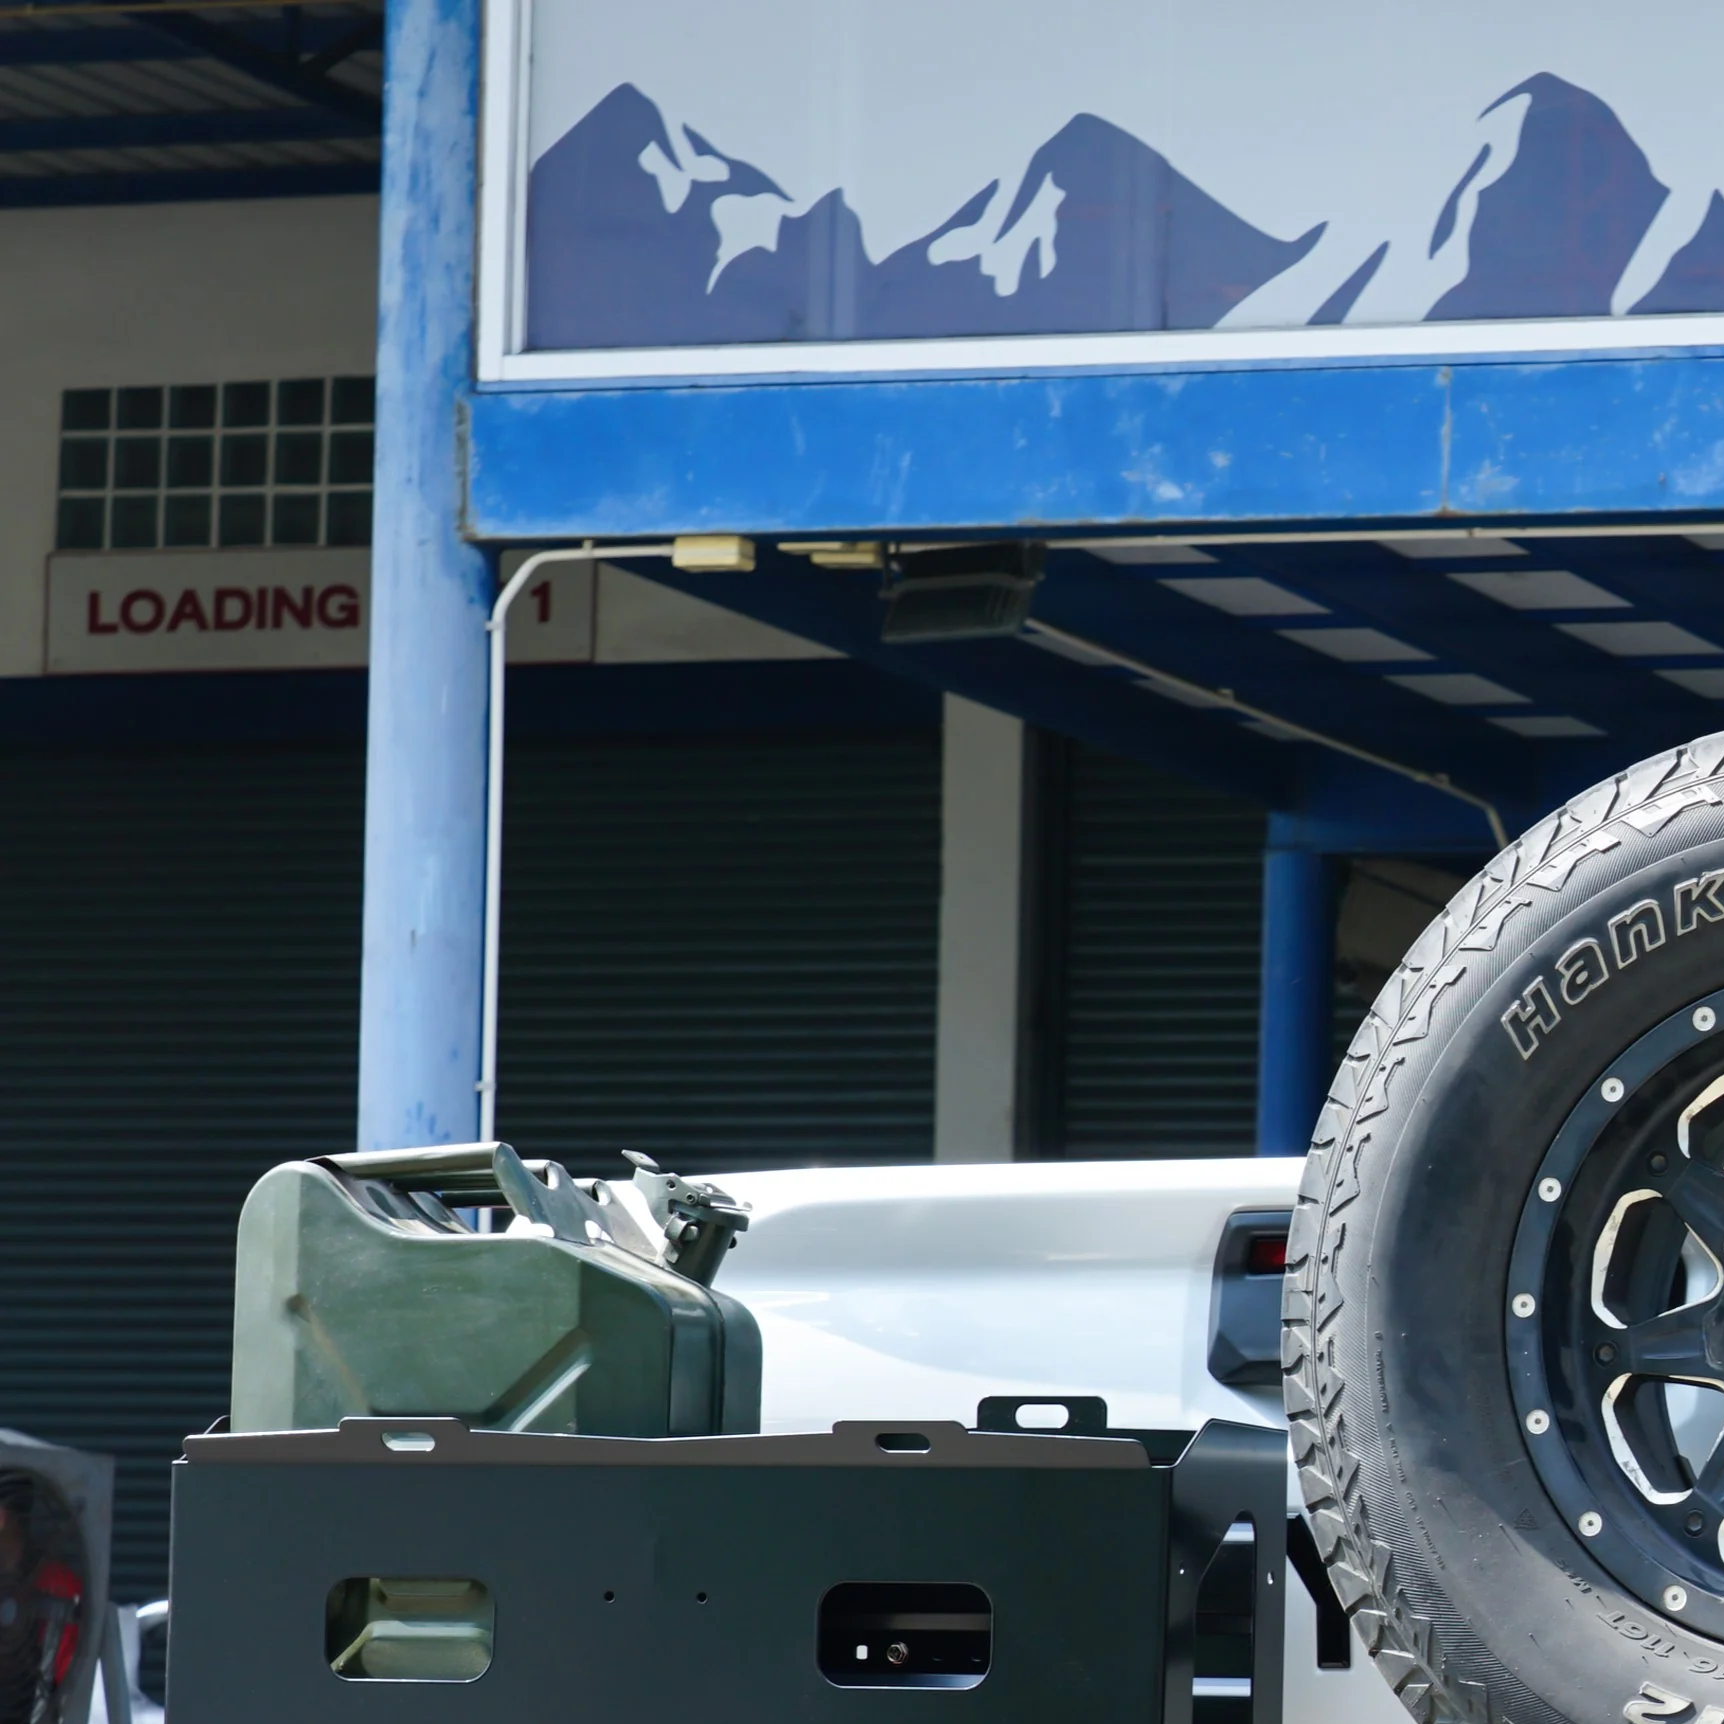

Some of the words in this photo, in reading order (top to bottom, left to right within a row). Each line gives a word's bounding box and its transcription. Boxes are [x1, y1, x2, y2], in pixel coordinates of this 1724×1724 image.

[87, 585, 360, 635] LOADING
[529, 580, 552, 623] 1
[1597, 1610, 1677, 1660] 116T
